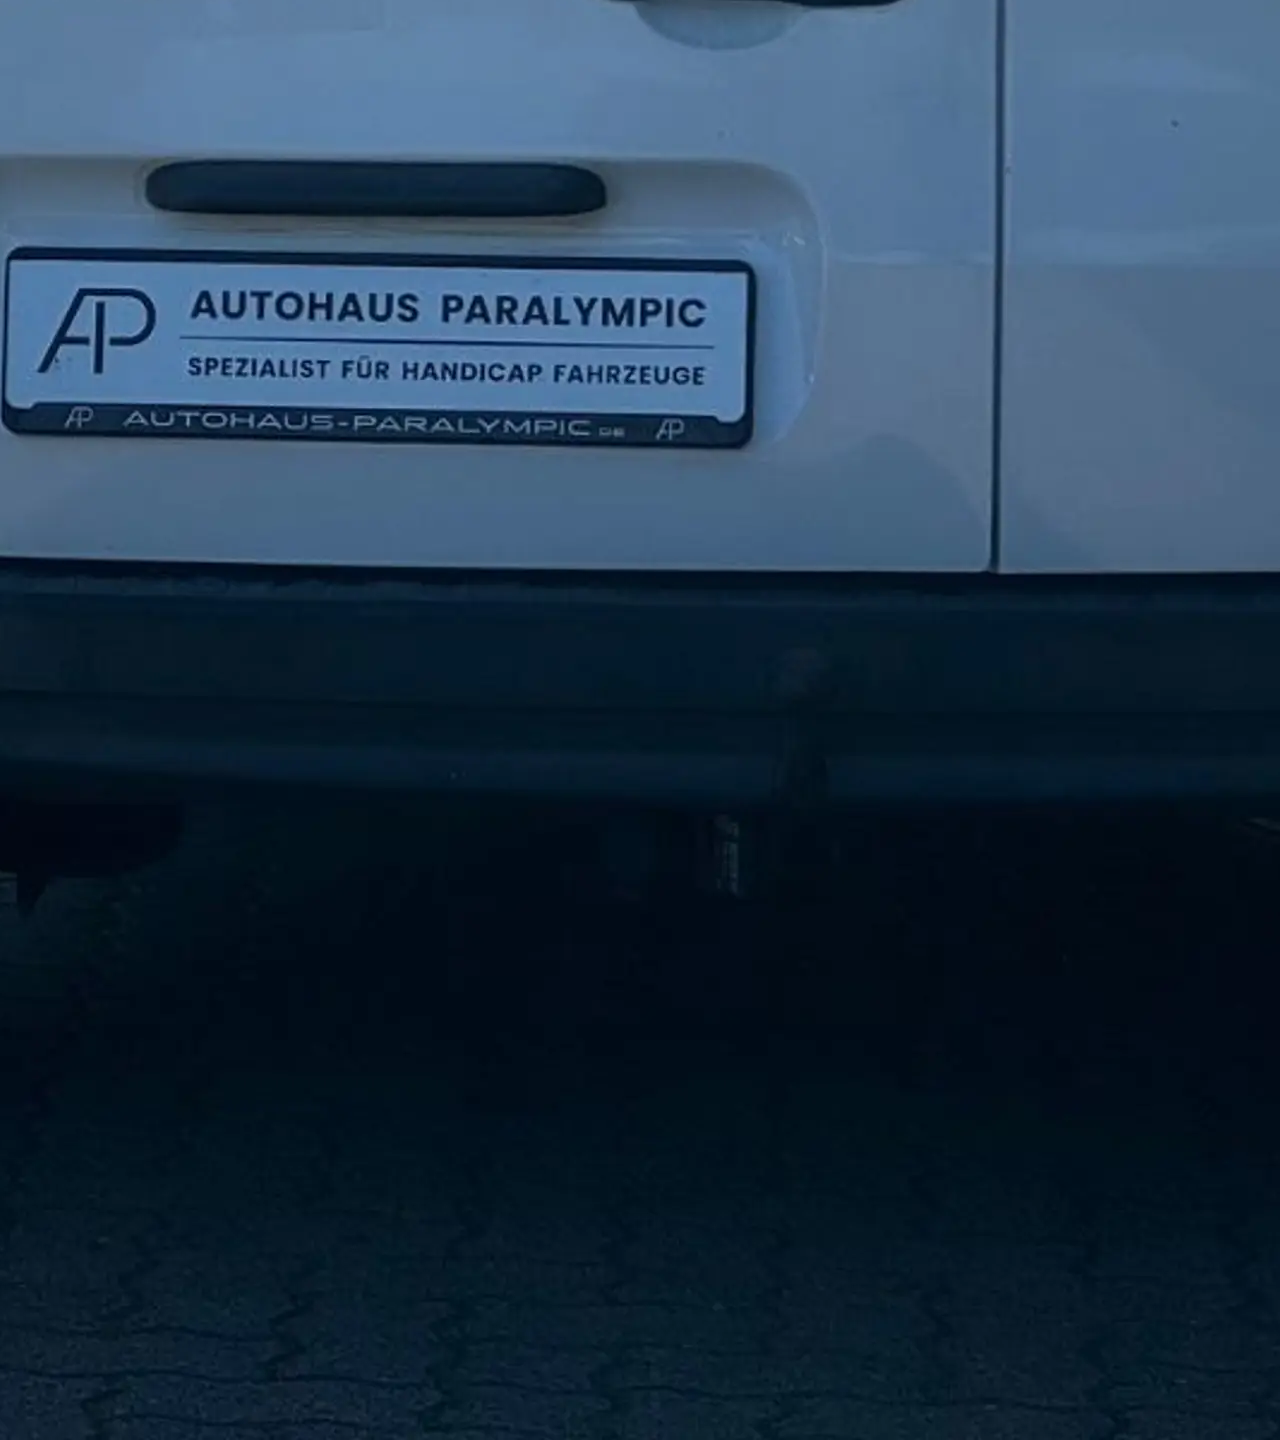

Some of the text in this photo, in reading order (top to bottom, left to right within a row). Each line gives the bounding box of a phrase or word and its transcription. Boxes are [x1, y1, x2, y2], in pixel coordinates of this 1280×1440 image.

[190, 290, 707, 328] AUTOHAUS PARALYMPIC
[36, 287, 157, 375] AP
[187, 355, 706, 386] SPEZIALIST FÜR HANDICAP FAHRZEUGE
